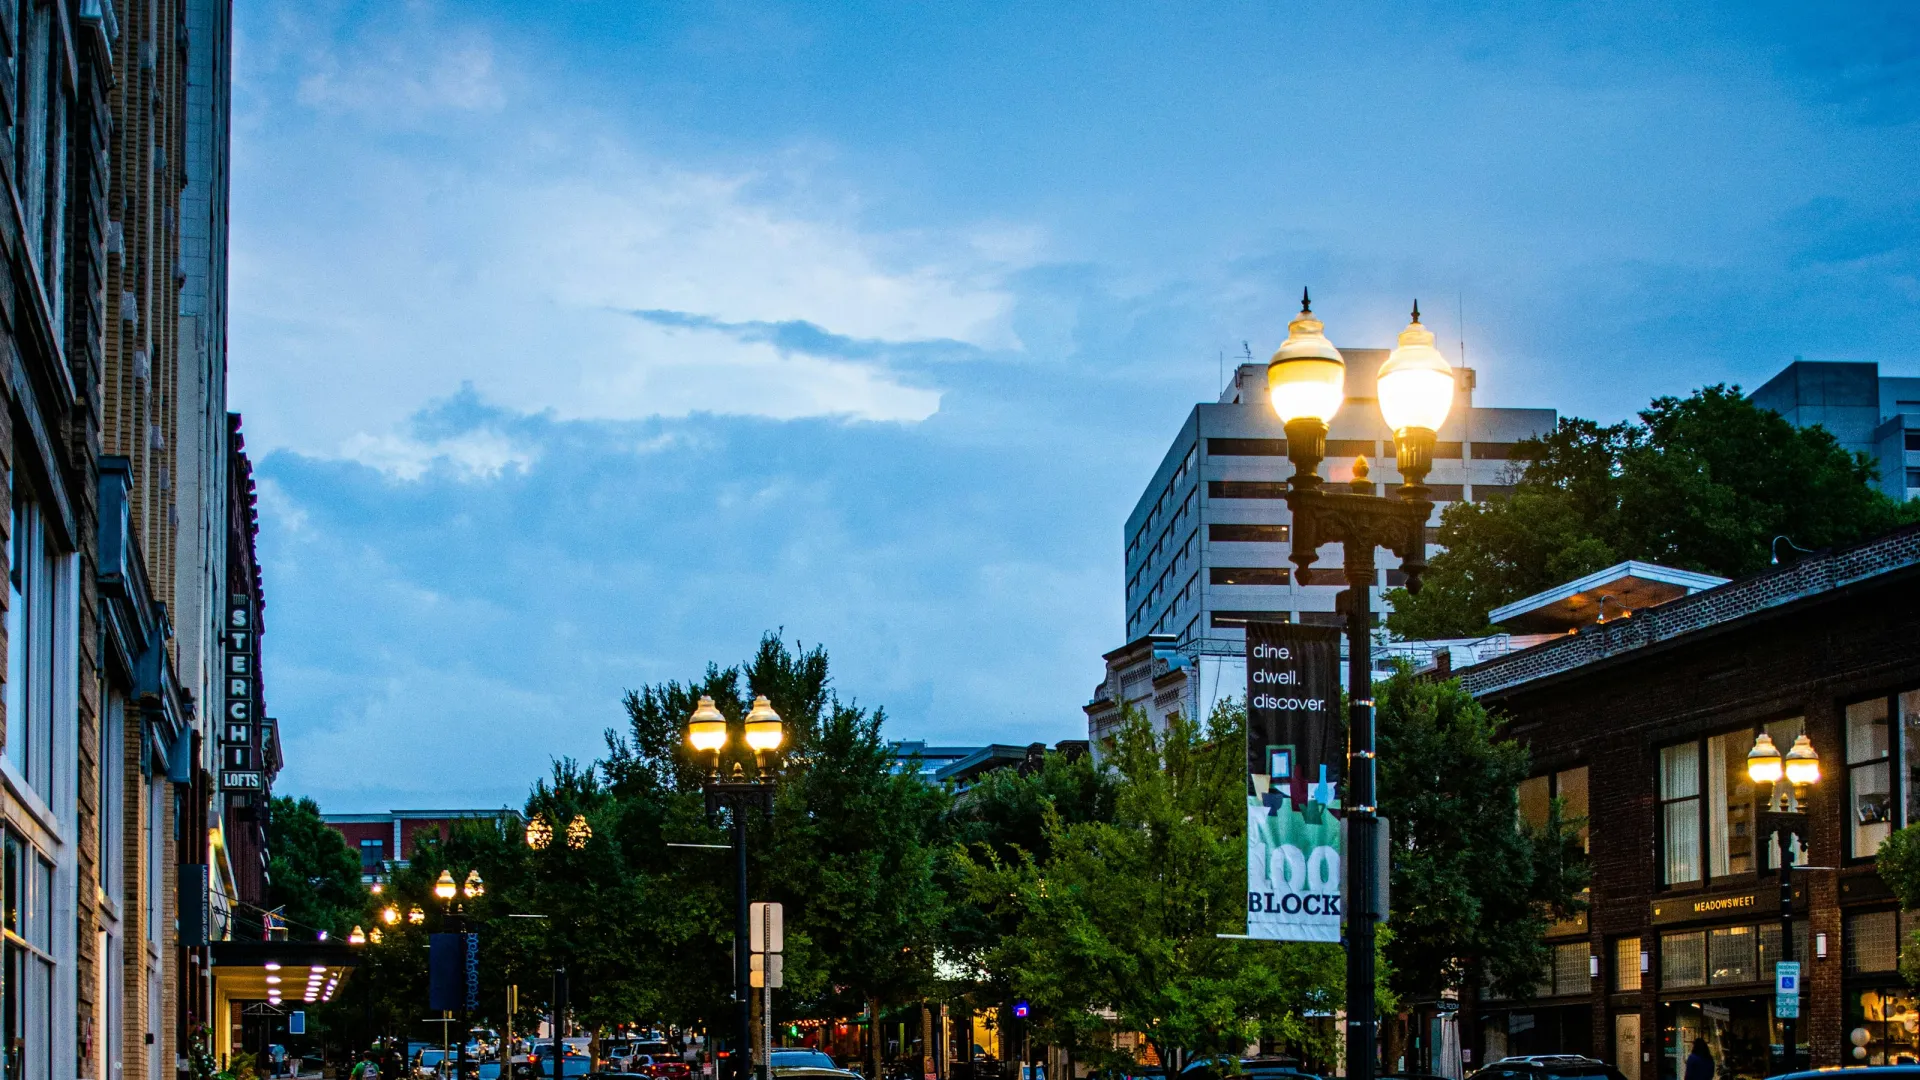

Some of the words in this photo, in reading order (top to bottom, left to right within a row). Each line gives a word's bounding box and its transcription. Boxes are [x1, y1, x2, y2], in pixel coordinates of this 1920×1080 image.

[1253, 644, 1293, 660] dine.
[1253, 669, 1301, 685] dwell.
[230, 609, 247, 765] STERCHI
[1253, 694, 1327, 712] discover.
[224, 773, 259, 787] LOFTS
[1248, 842, 1340, 891] 100
[1249, 892, 1341, 915] BLOCK
[1694, 896, 1755, 912] MEADOWSWEET
